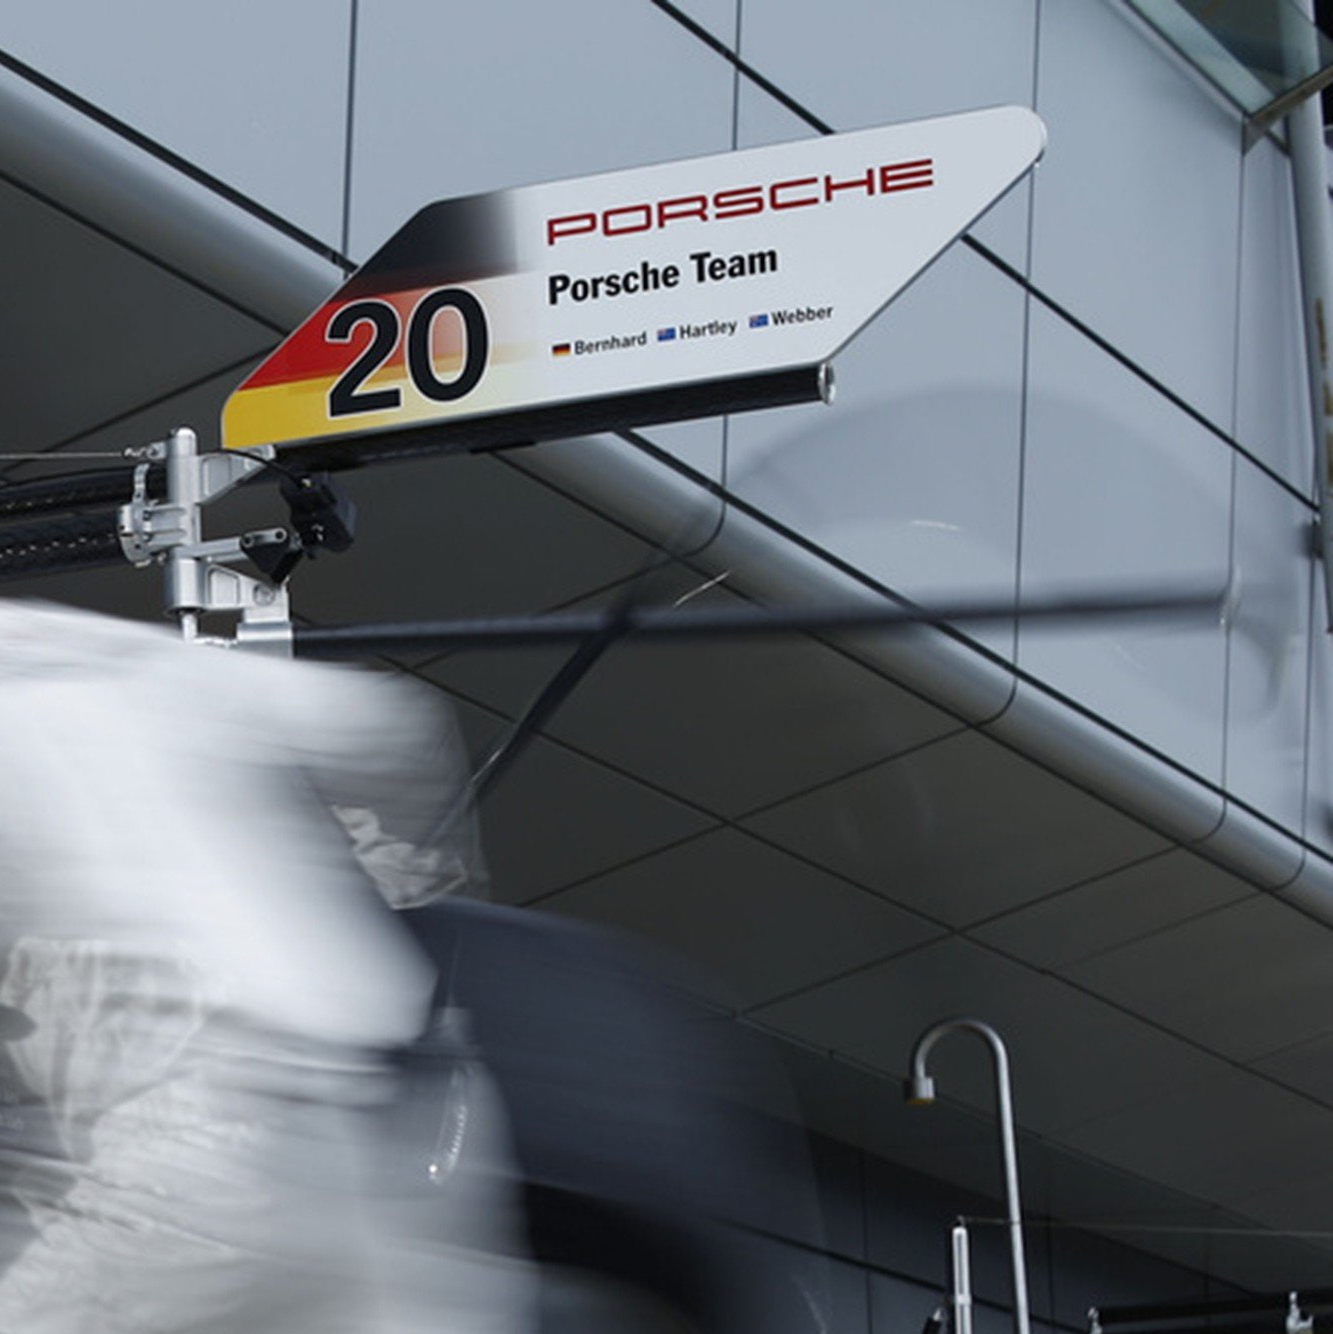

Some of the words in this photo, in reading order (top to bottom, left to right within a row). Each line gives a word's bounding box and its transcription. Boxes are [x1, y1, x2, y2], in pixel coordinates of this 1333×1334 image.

[547, 159, 933, 245] PORSCHE
[548, 262, 680, 305] Porsche
[690, 248, 778, 284] Team
[325, 284, 490, 418] 20
[574, 332, 647, 355] Bernhard
[679, 320, 738, 340] Hartley
[771, 306, 834, 327] Webber
